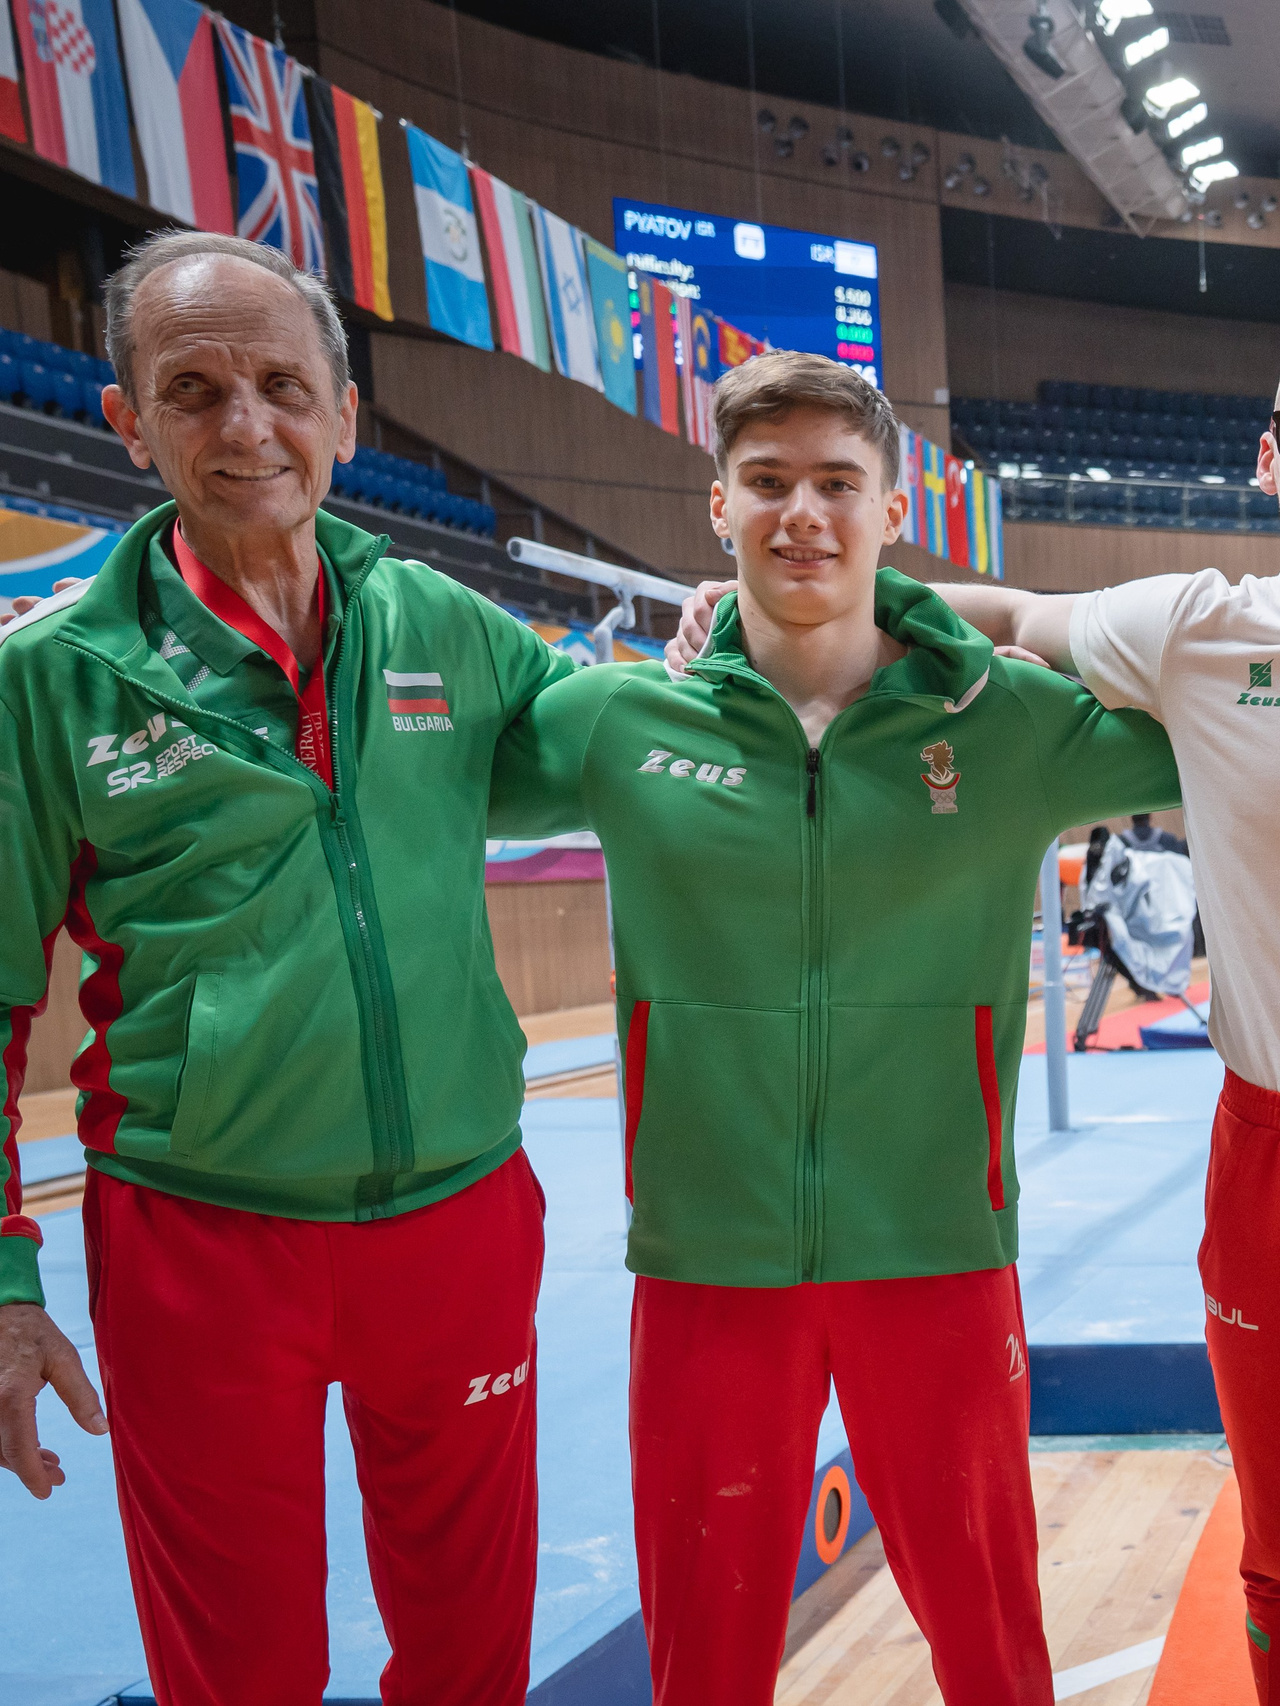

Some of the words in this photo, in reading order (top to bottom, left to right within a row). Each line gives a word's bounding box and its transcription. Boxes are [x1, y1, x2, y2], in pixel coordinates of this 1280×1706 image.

[624, 209, 692, 241] PYATOV
[392, 715, 454, 732] BULGARIA
[155, 734, 197, 765] SPORT
[637, 749, 748, 786] Zeus
[107, 761, 155, 798] SR
[1205, 1293, 1260, 1331] BUL
[463, 1354, 531, 1406] Zeu
